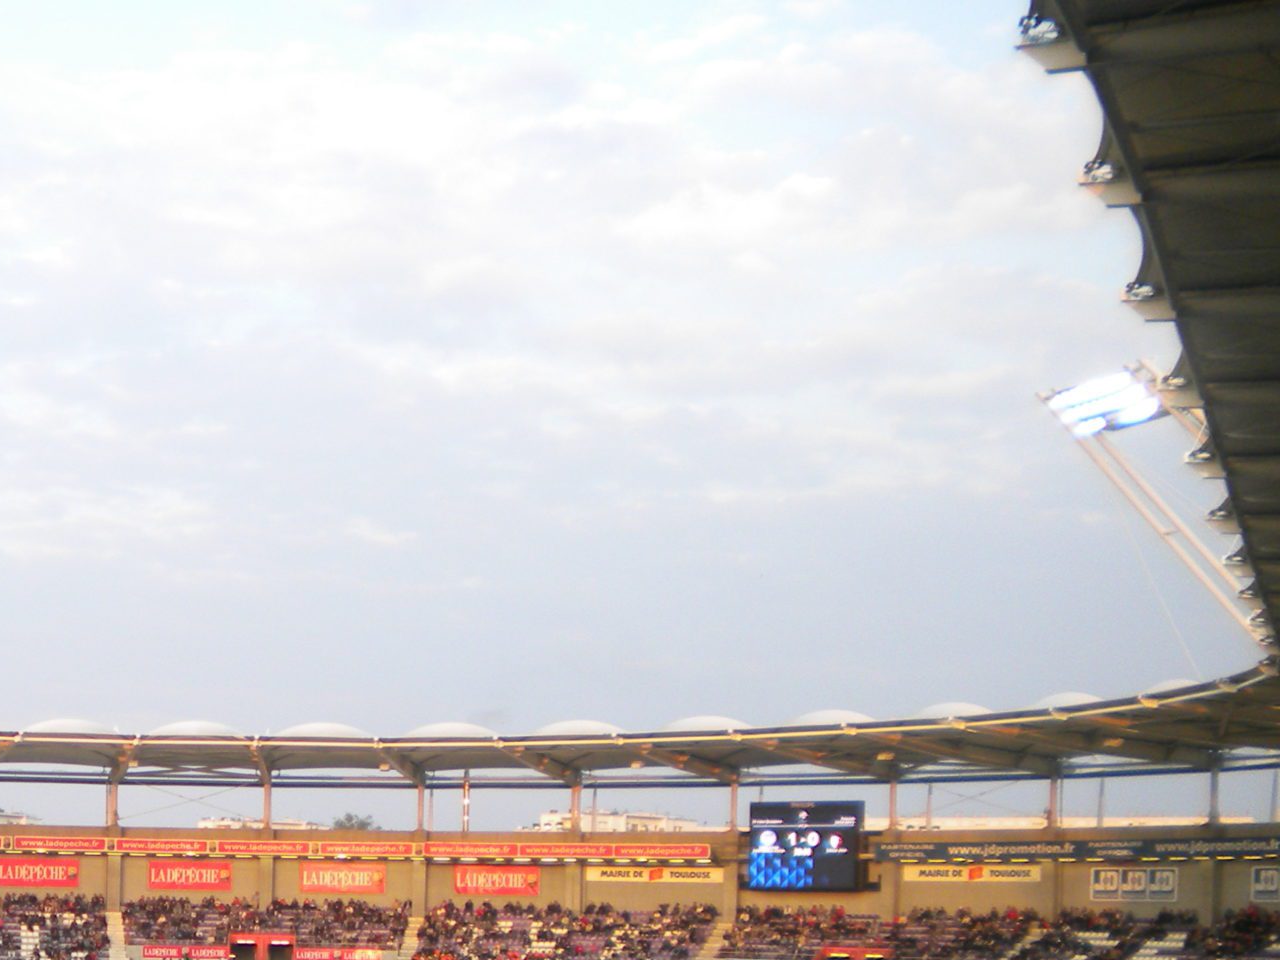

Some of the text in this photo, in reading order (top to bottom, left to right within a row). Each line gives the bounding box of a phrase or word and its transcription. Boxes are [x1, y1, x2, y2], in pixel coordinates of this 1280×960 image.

[20, 839, 99, 848] www.ladepeche.fr
[122, 841, 200, 850] www.ladepeche.fr
[223, 843, 303, 852] www.ladepeche.fr
[327, 844, 406, 853] www.ladepeche.fr
[429, 844, 510, 855] www.ladepeche.fr
[525, 845, 606, 856] www.ladepeche.fr
[620, 846, 701, 857] www.ladepeche.fr
[947, 843, 1075, 856] www.jdpromotion.fr
[600, 869, 711, 879] MAIRIE DE TOULOUSE
[919, 869, 1031, 878] MAIRIE DE TOULOUSE
